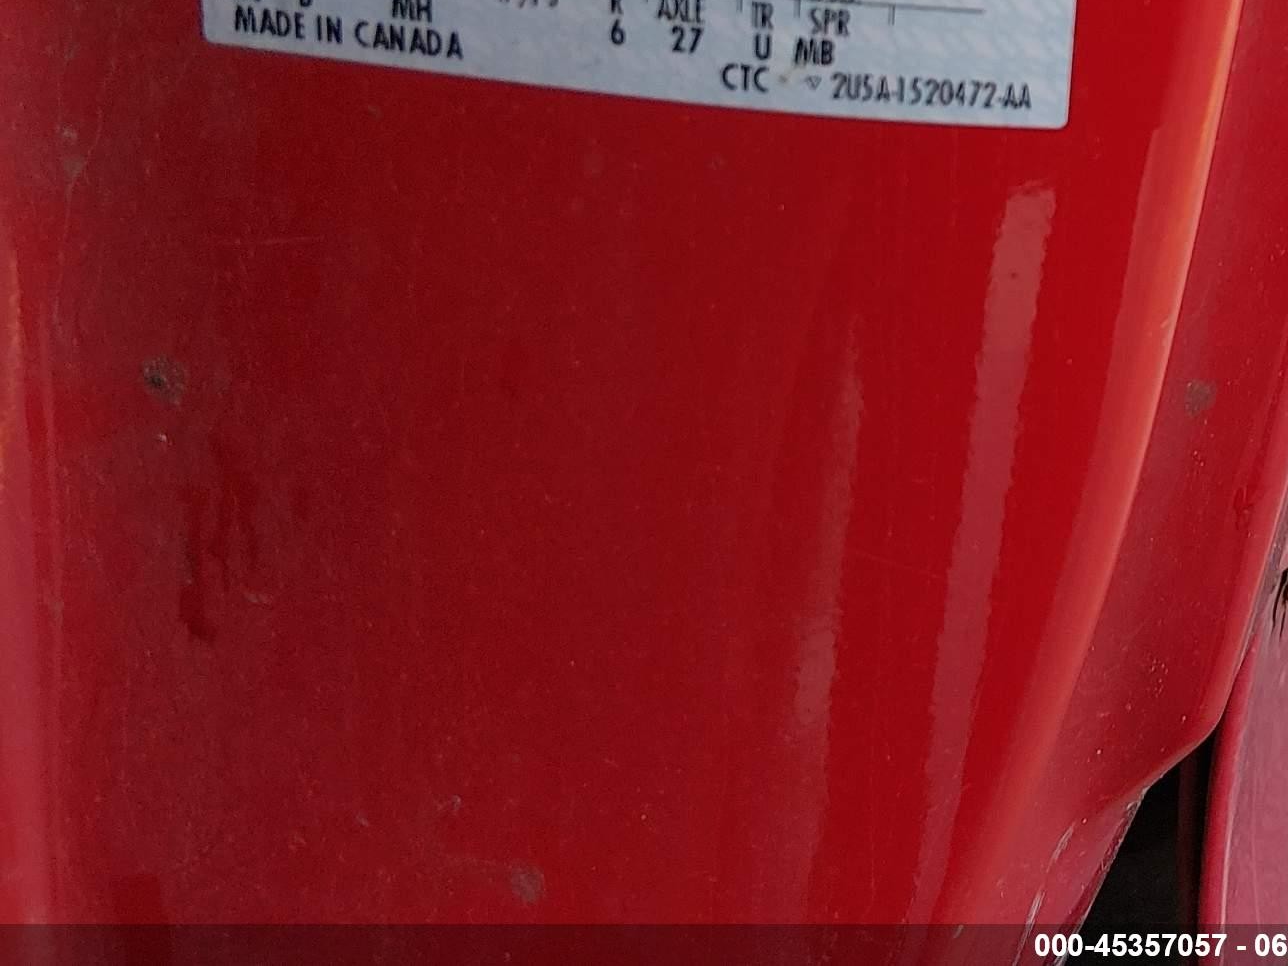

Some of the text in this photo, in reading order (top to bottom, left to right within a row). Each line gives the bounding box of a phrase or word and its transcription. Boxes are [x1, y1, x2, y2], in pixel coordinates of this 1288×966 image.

[234, 6, 464, 60] MADE IN CANADA
[752, 1, 774, 30] TR
[809, 8, 851, 36] SPR
[610, 19, 625, 45] 6
[671, 26, 703, 54] 27
[754, 33, 772, 60] U
[794, 37, 835, 67] MB
[721, 63, 770, 94] CTC
